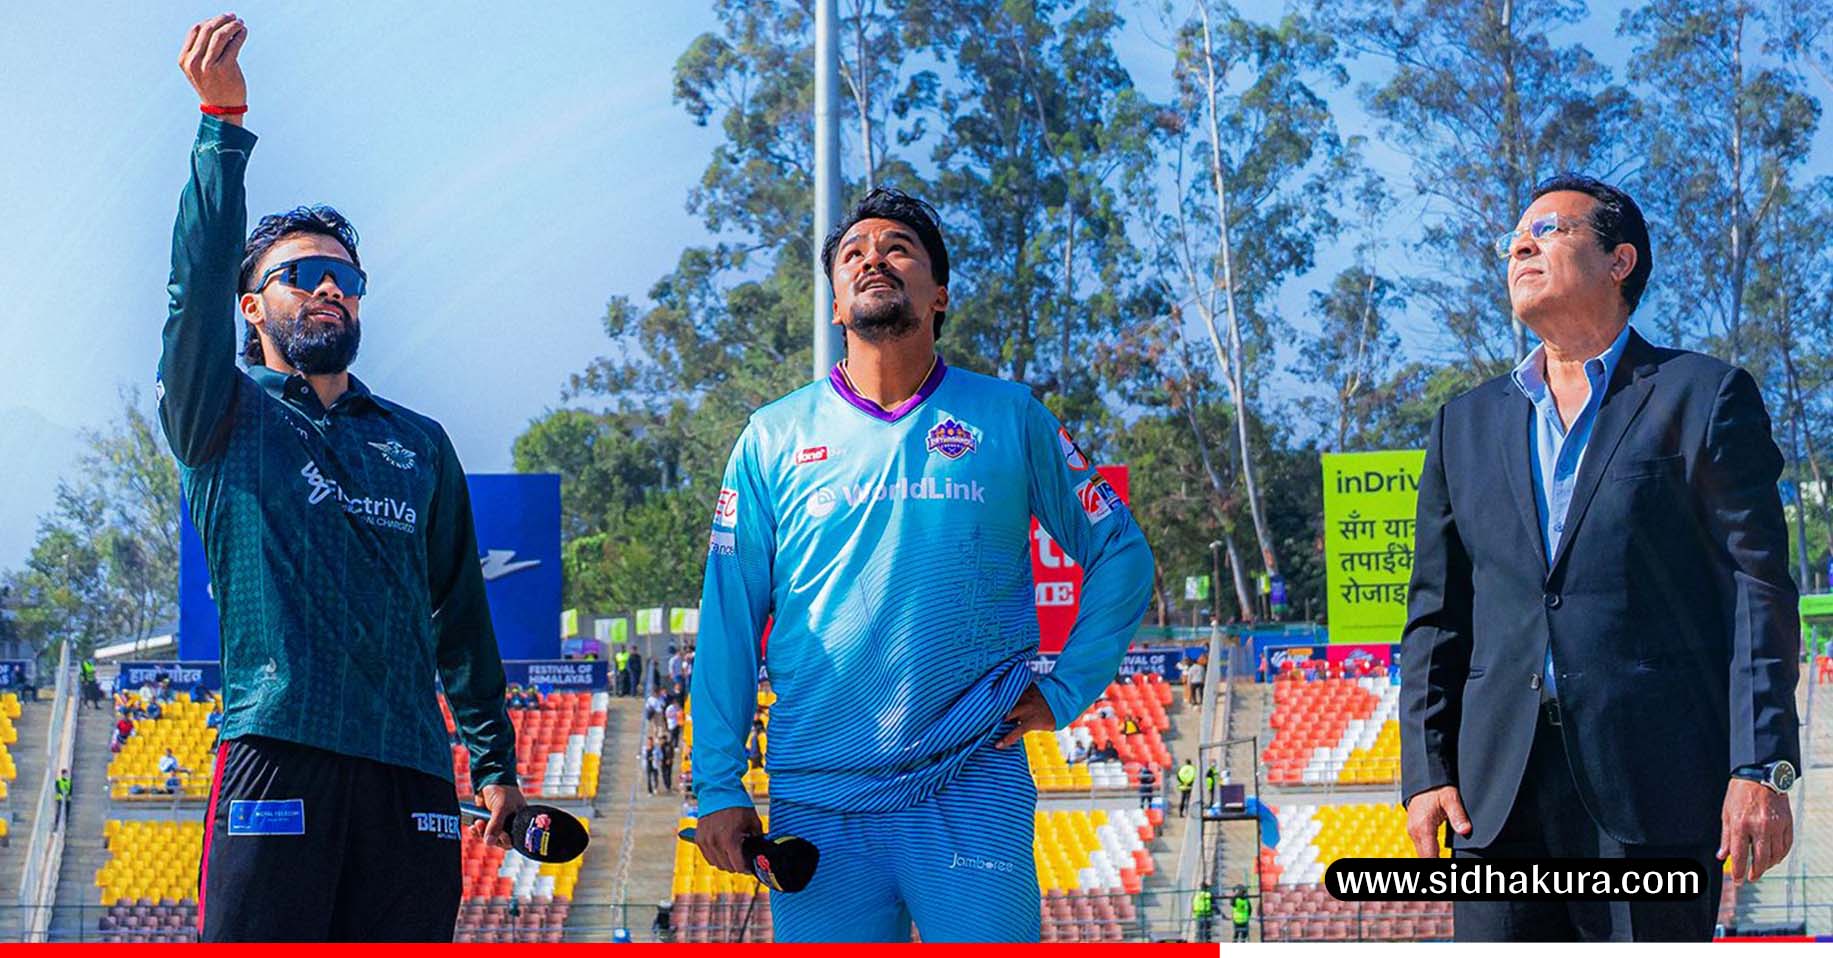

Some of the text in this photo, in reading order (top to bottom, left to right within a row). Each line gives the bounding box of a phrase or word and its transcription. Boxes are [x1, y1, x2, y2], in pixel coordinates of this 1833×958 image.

[842, 477, 985, 506] WorldLink
[1336, 468, 1420, 494] inDriv
[1337, 510, 1376, 540] सँग
[528, 664, 593, 674] FESTIVAL OF
[1150, 655, 1166, 665] OF
[528, 674, 593, 684] HIMALAYAS
[411, 812, 462, 840] BETTER
[949, 852, 1013, 873] Jamboree
